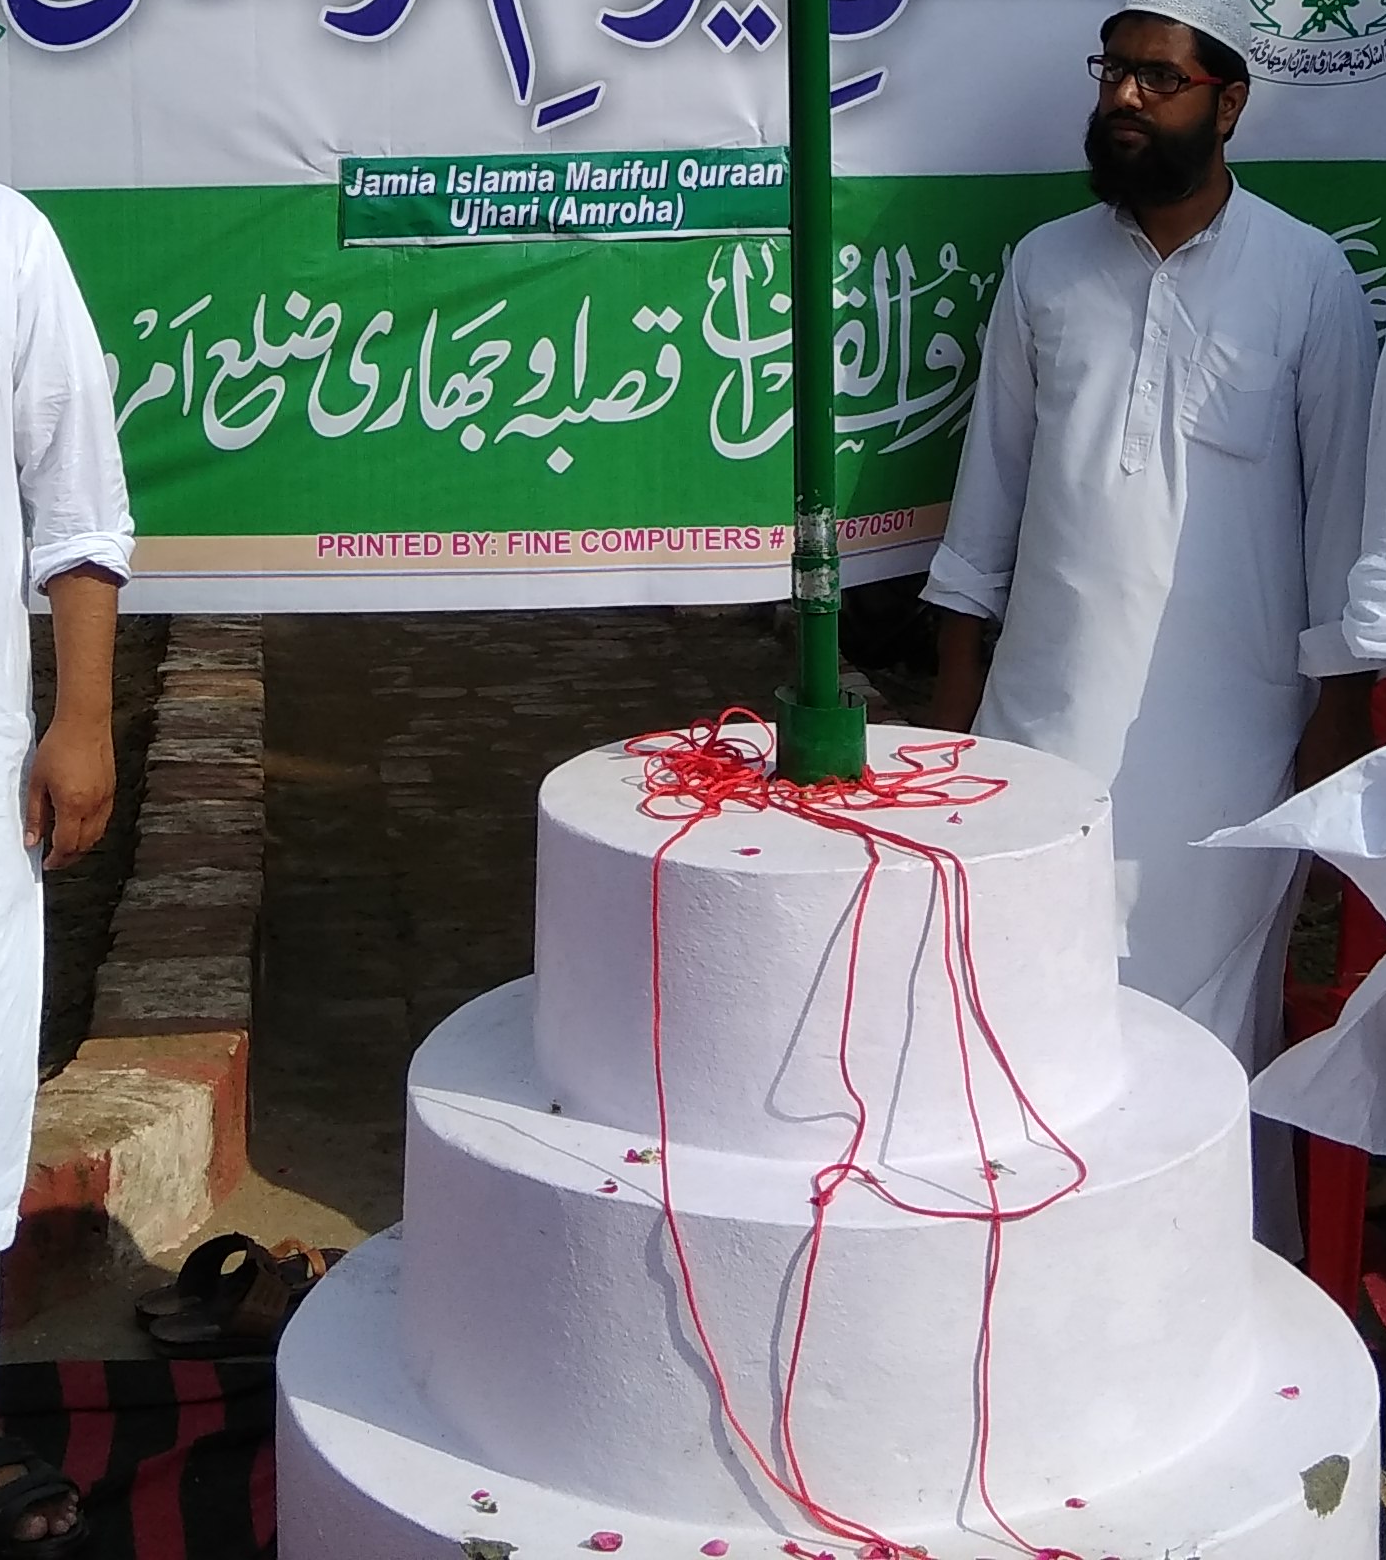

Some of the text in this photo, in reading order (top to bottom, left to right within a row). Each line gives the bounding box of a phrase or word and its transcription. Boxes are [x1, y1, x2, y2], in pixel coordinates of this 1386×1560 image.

[345, 158, 784, 198] Jamia Islamia Mariful Quraan
[449, 193, 685, 235] Ujhari (Amroha)
[202, 290, 343, 452] ضلع
[493, 305, 683, 474] قصبہ
[317, 534, 443, 558] PRINTED
[450, 532, 498, 557] BY:
[506, 530, 572, 555] FINE
[578, 527, 761, 554] COMPUTERS
